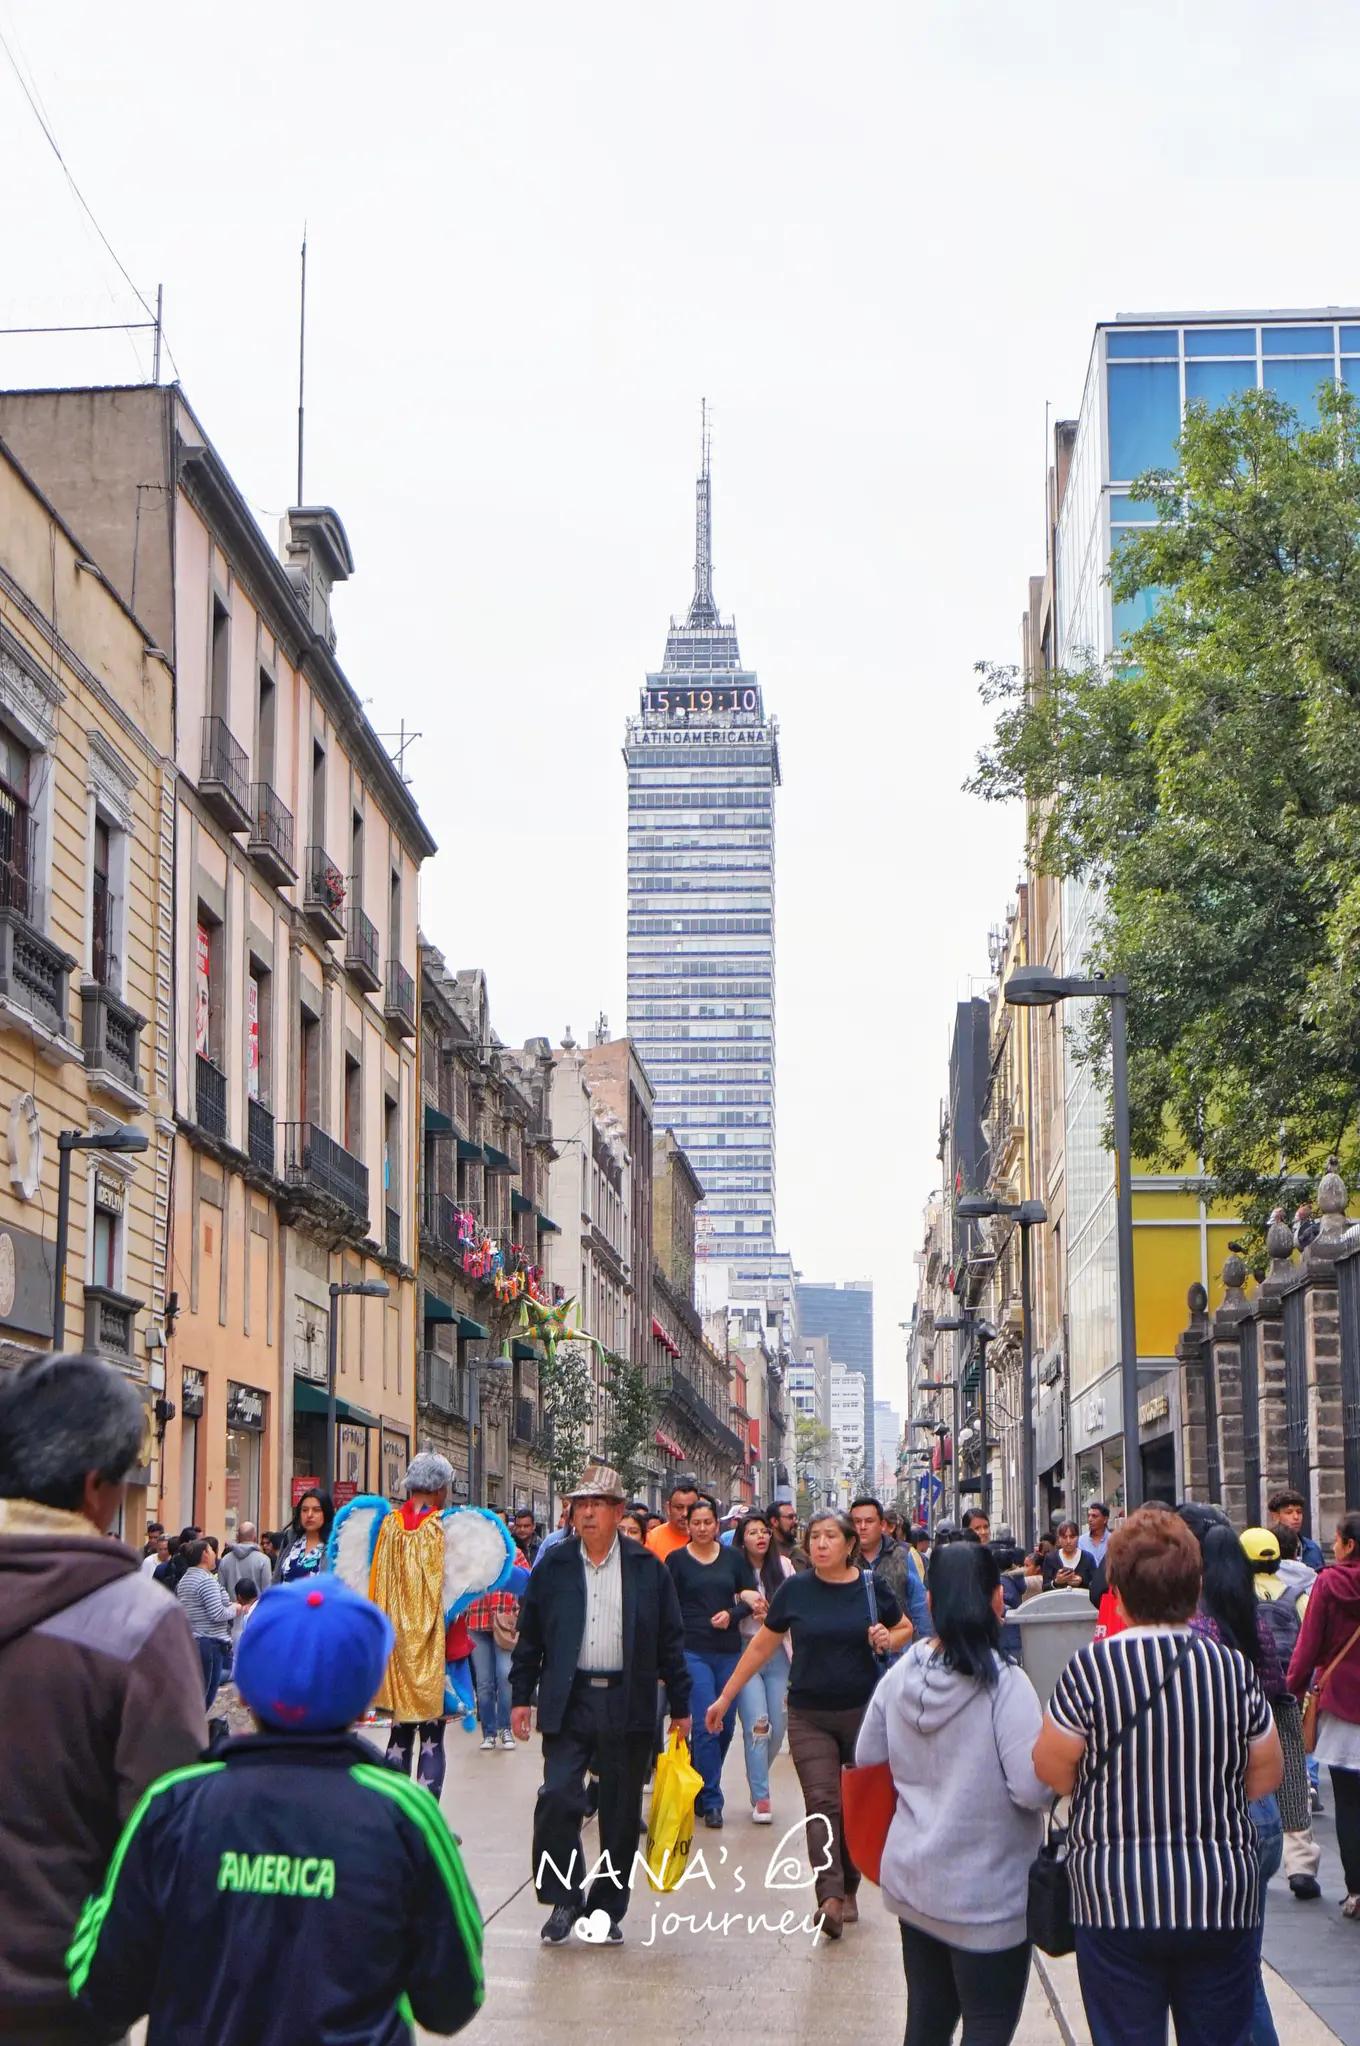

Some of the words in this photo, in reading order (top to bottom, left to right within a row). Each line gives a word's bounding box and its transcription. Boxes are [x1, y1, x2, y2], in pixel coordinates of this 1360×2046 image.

[644, 689, 756, 712] 15:19:10
[634, 731, 764, 745] LATINOAMERICANA
[216, 1850, 336, 1899] AMERICA
